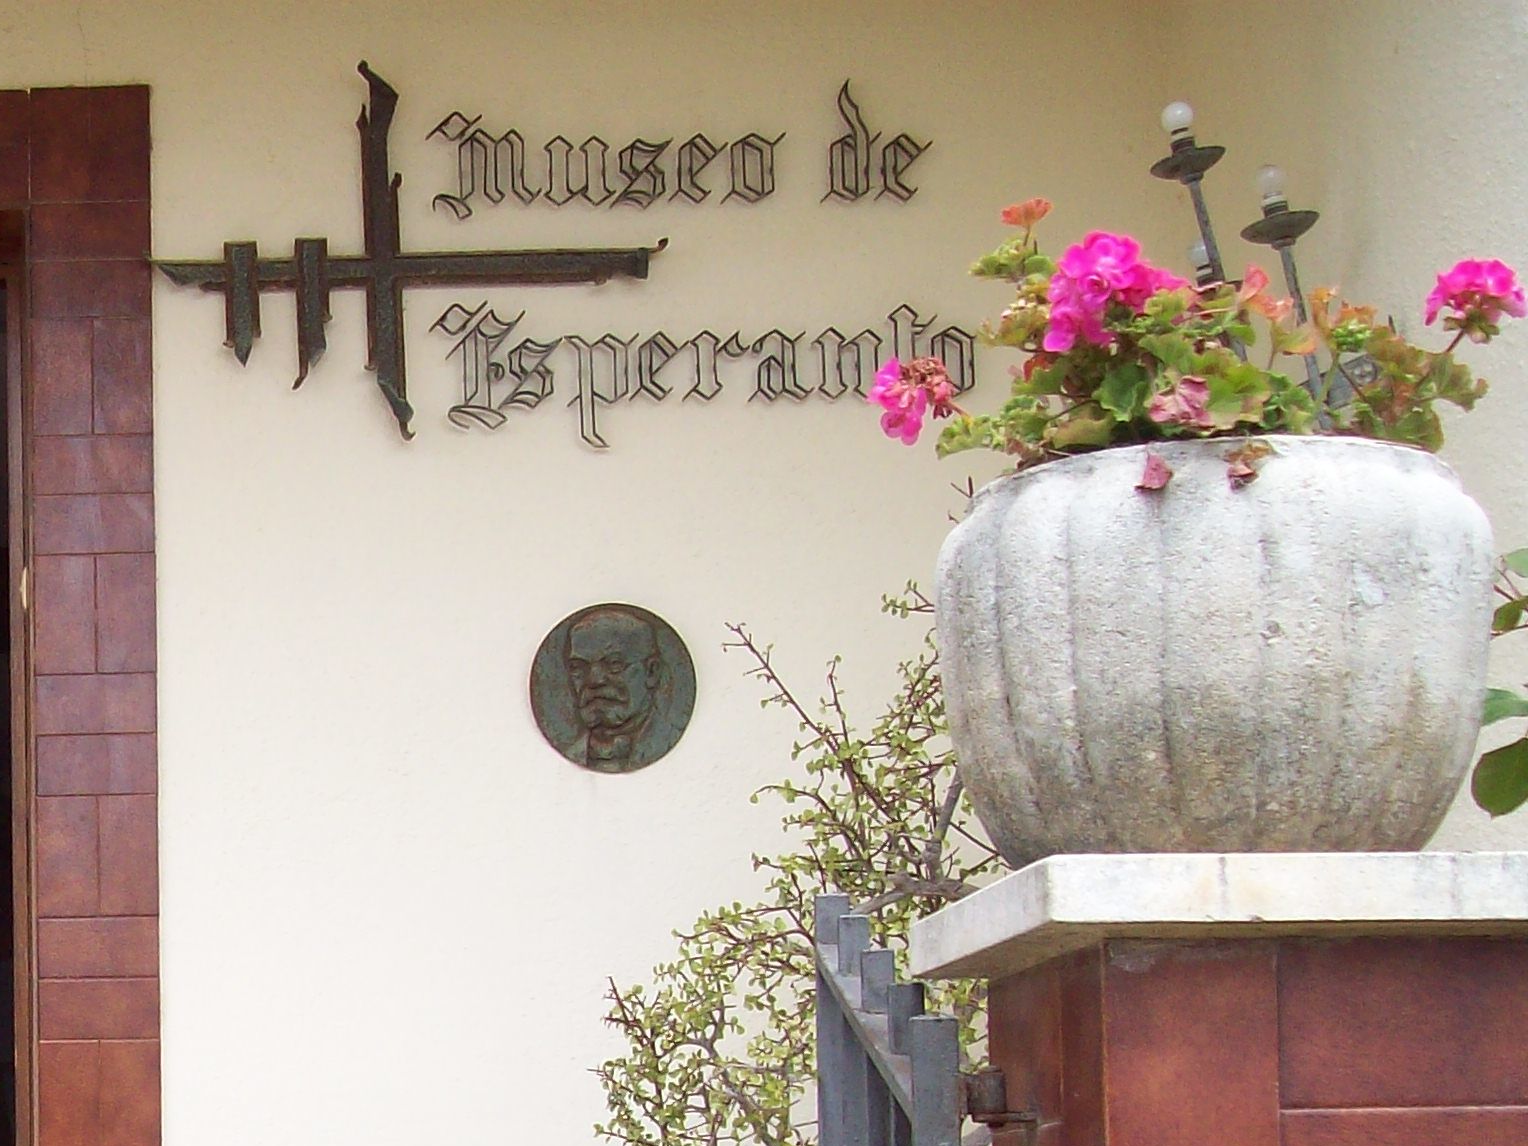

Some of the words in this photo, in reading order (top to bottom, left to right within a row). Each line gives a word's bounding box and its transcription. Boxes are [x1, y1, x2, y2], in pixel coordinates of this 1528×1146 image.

[426, 110, 788, 220] Museo
[819, 78, 934, 204] de
[428, 300, 978, 449] Esperanto
